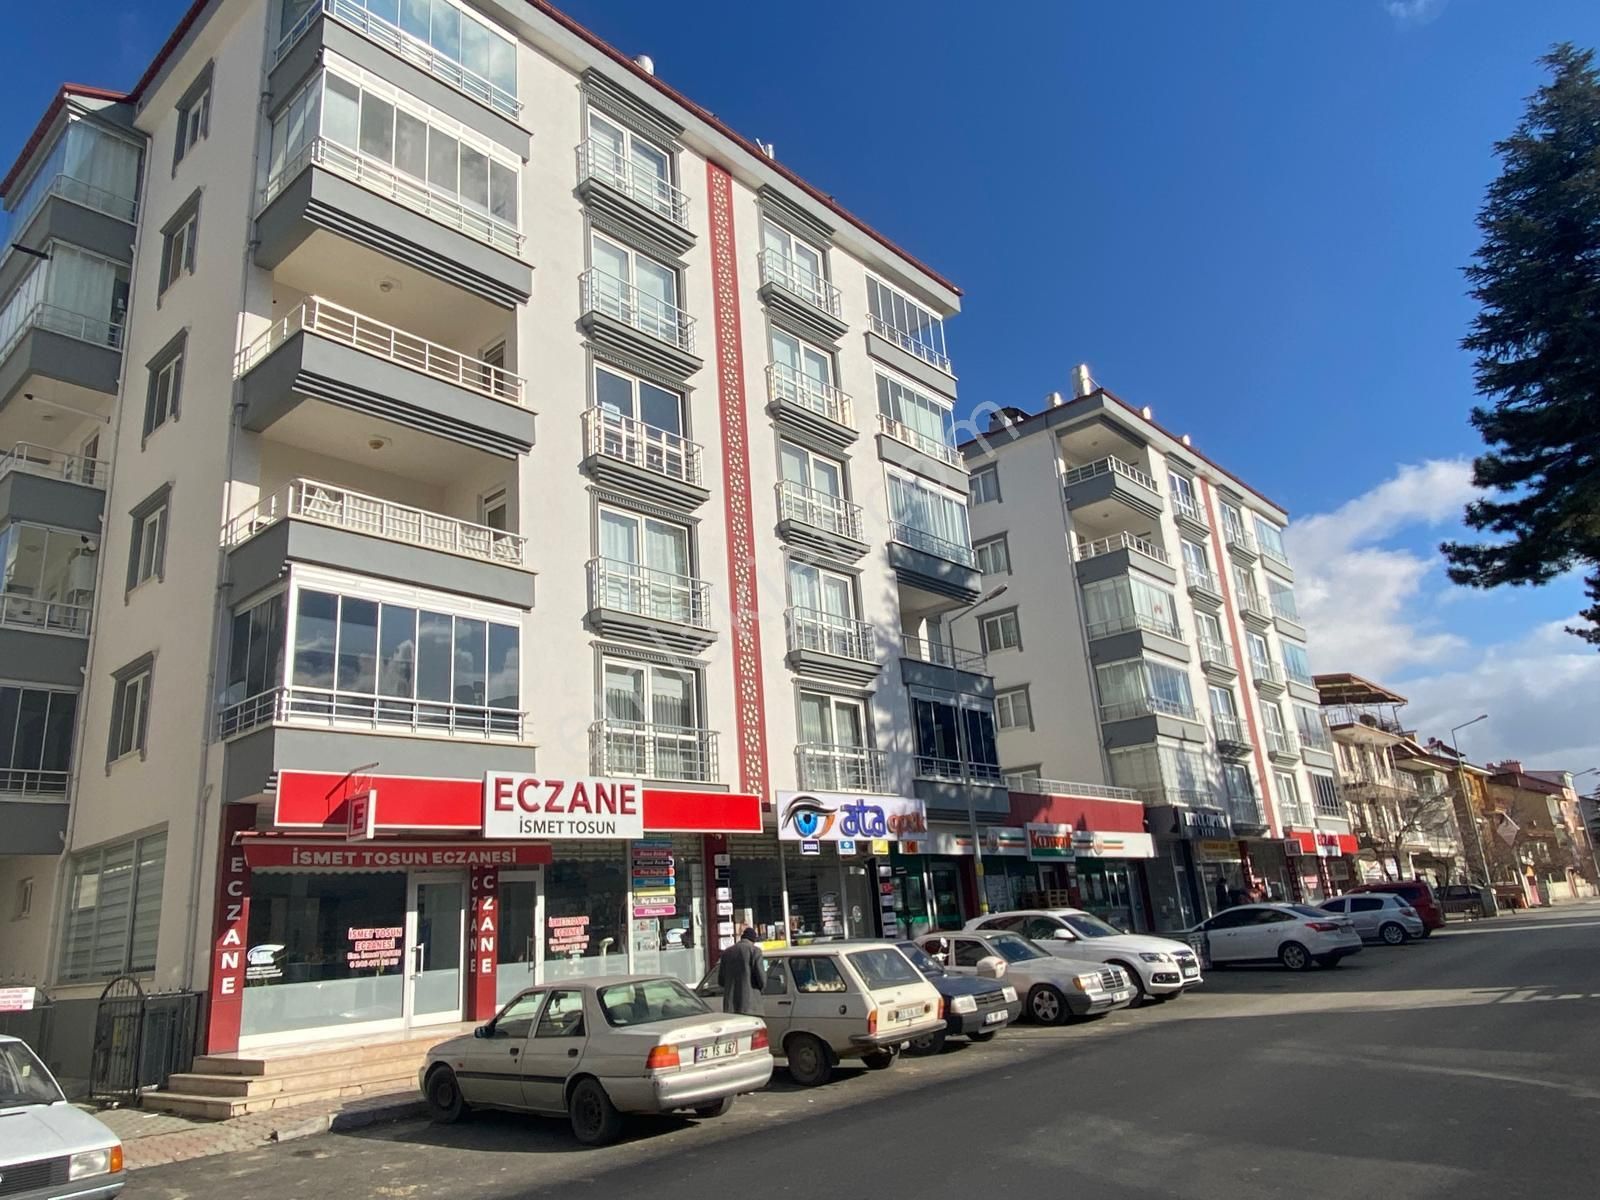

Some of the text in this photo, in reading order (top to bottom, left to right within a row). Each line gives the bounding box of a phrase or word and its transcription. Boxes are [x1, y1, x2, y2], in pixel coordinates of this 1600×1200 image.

[494, 777, 637, 815] ECZANE
[353, 802, 364, 830] E
[519, 816, 616, 834] İSMET TOSUN
[840, 799, 886, 838] ata
[292, 847, 517, 865] İSMET TOSUN ECZANESİ
[221, 857, 243, 994] ECZANE
[348, 927, 403, 940] İSMET TOSUN
[470, 865, 478, 973] CZANE
[481, 866, 494, 973] CZANE
[355, 938, 395, 951] ECZANESİ
